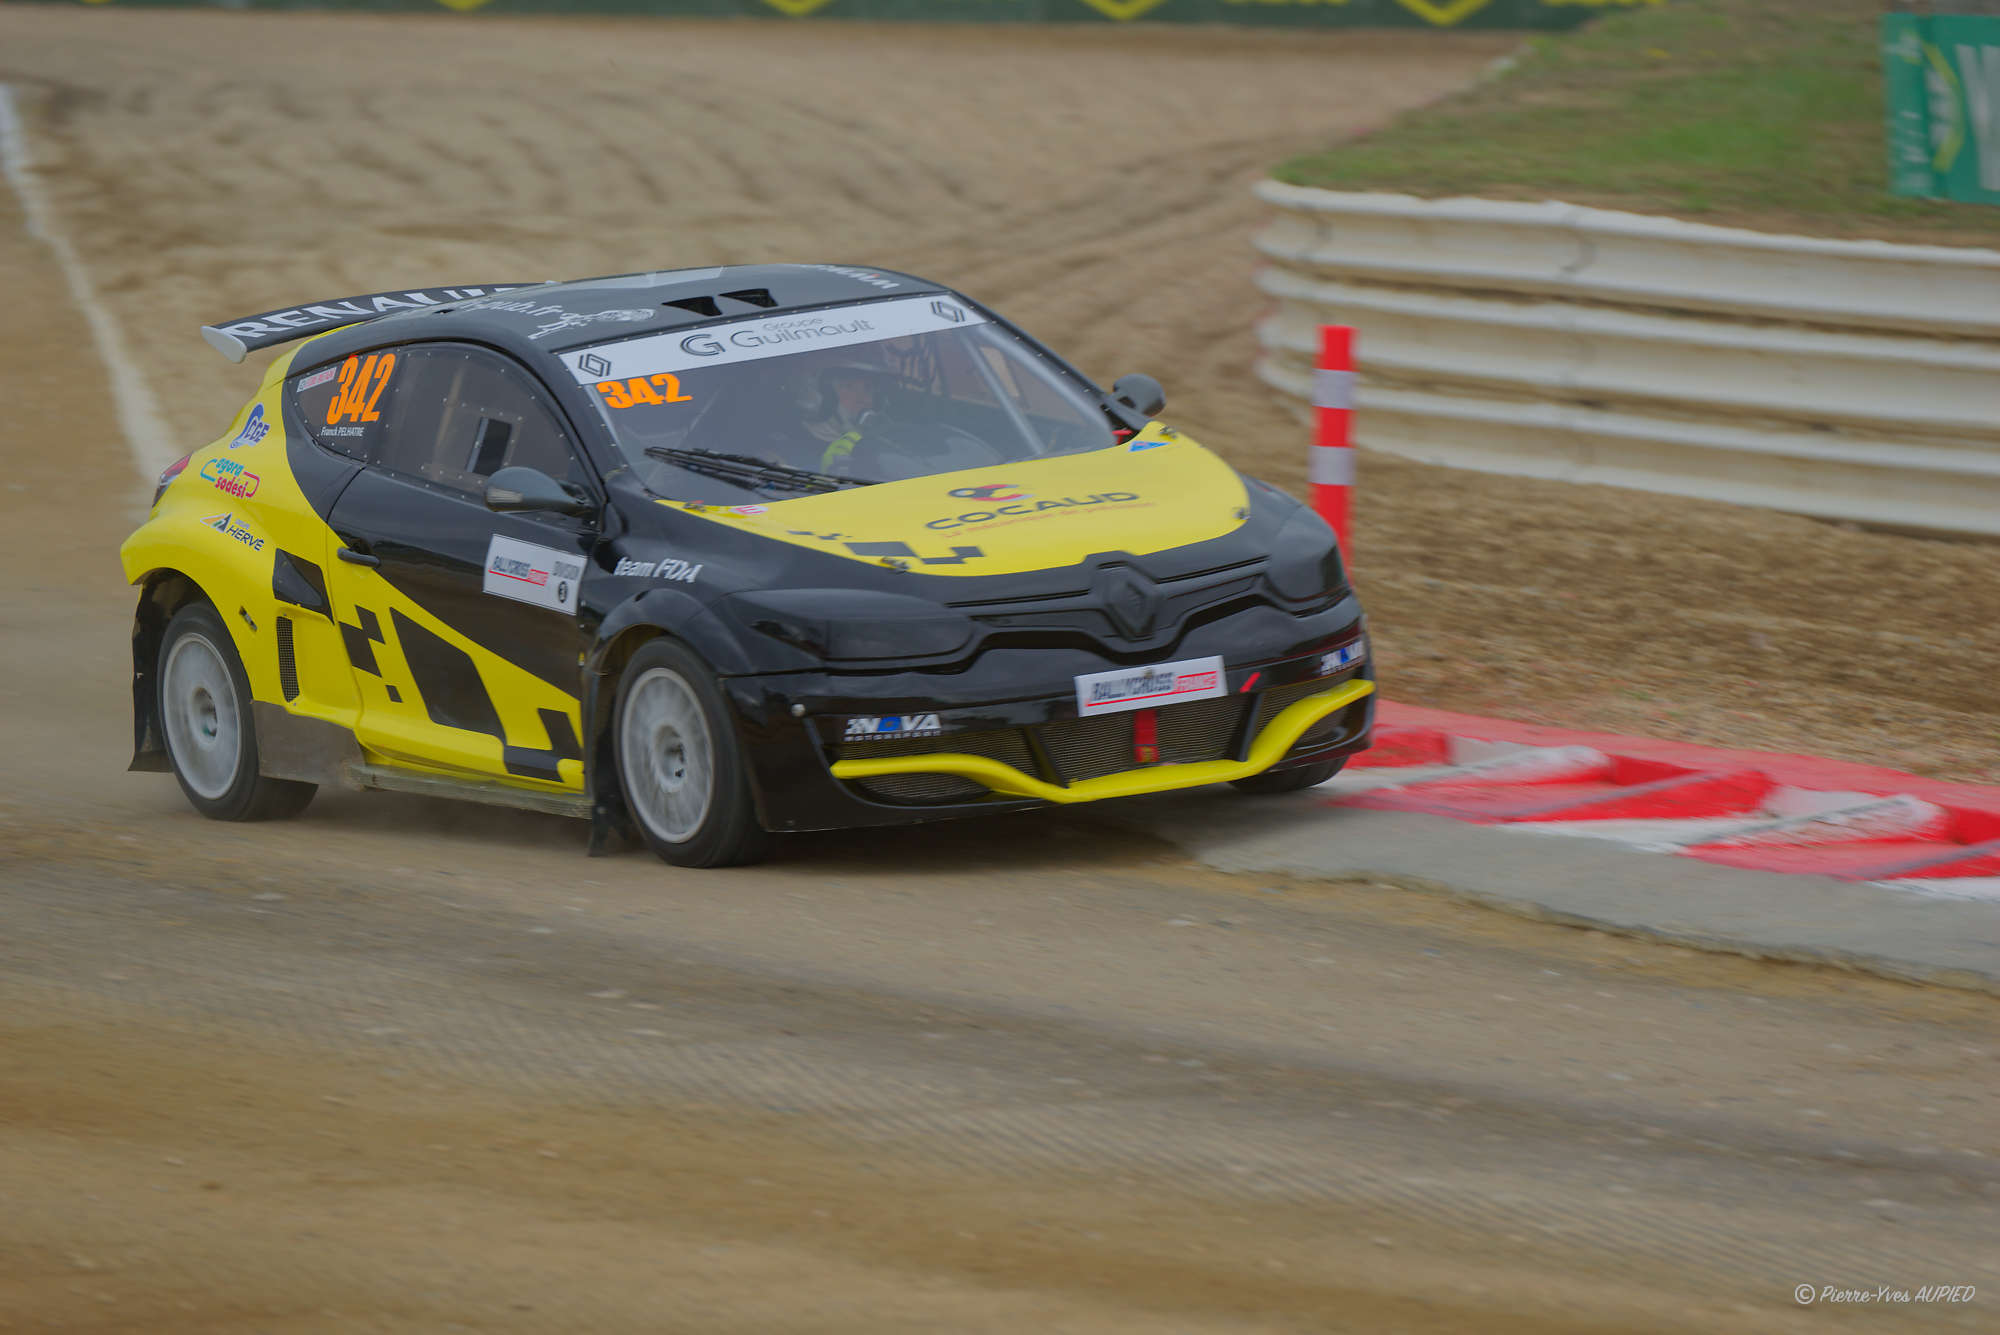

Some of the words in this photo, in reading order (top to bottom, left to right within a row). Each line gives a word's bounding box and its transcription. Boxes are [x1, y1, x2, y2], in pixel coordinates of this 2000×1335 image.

[730, 319, 875, 348] Guilmault
[326, 353, 396, 425] 342
[596, 373, 693, 409] 342
[925, 491, 1140, 531] COCAUD
[613, 556, 657, 578] team
[652, 558, 704, 583] FDA
